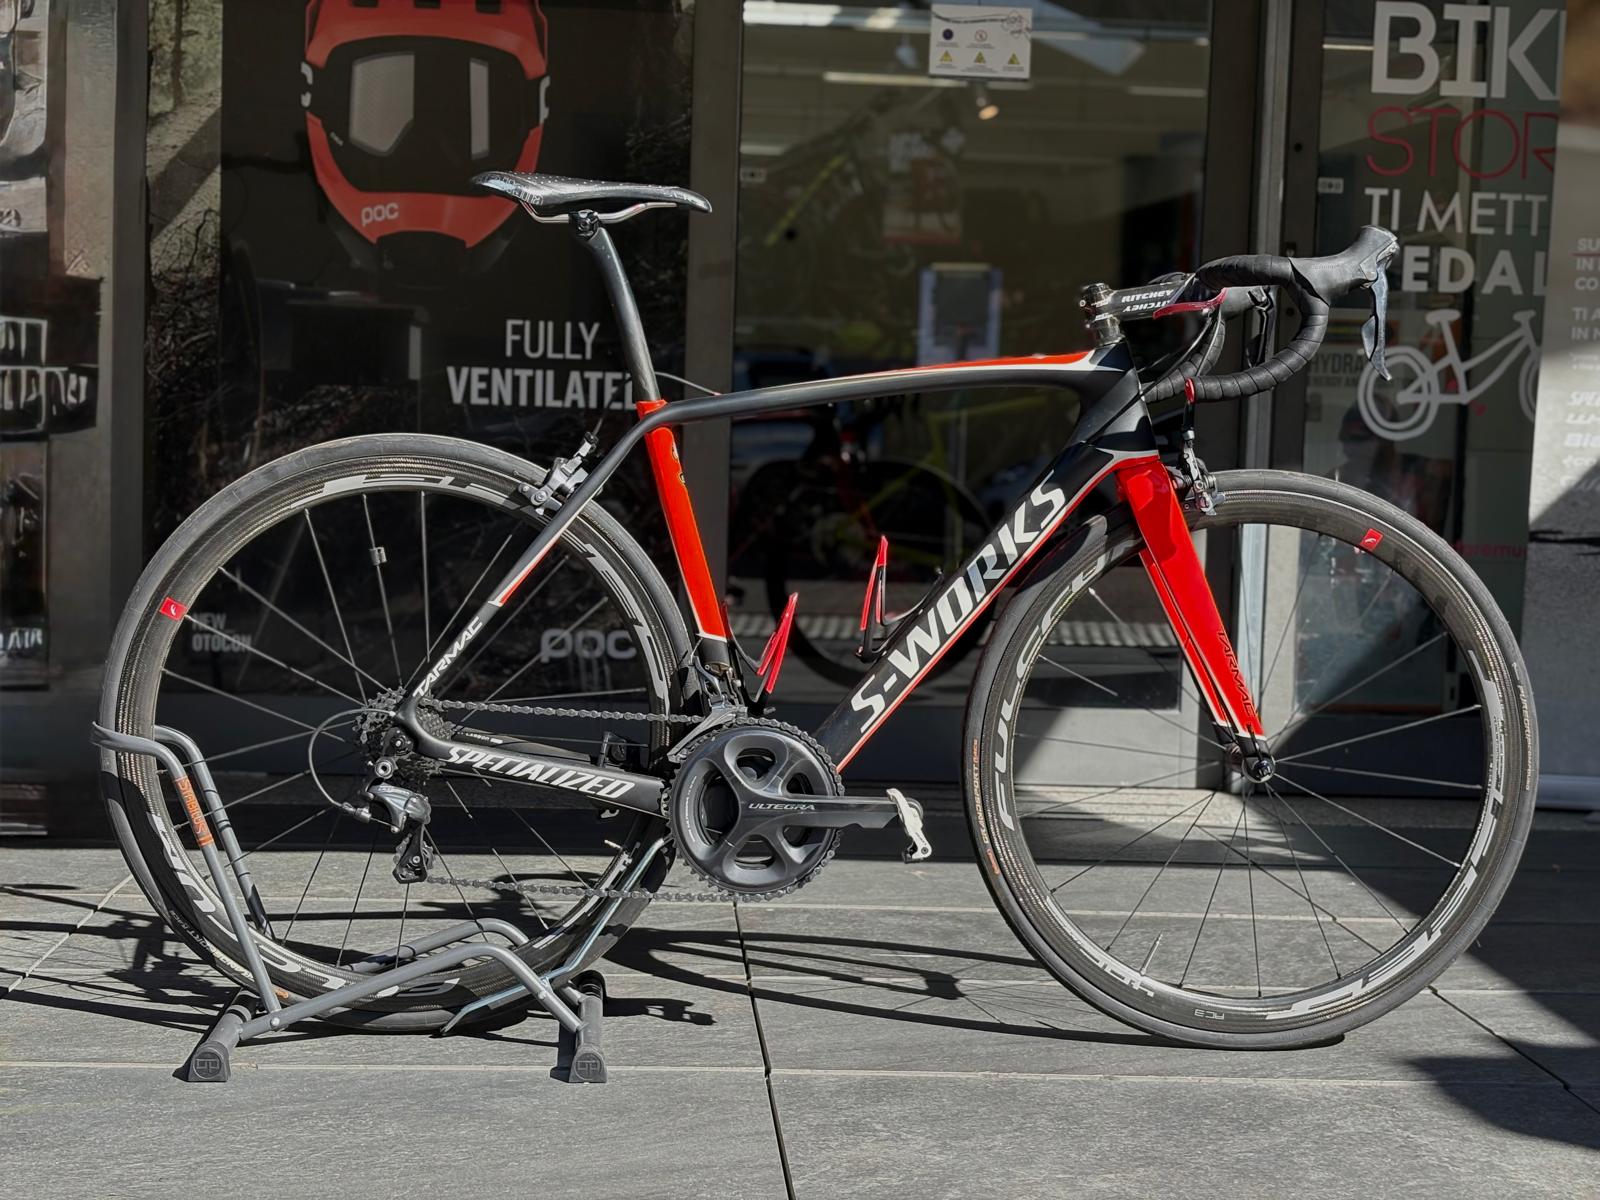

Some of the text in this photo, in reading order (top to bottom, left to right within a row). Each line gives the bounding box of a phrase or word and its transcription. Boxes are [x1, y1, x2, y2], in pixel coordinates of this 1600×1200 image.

[1371, 0, 1566, 100] BIK
[361, 202, 399, 228] poc
[1364, 187, 1548, 237] TI METT
[1402, 245, 1548, 295] EDAL
[1121, 289, 1174, 303] RITCHEY
[505, 319, 600, 360] FULLY
[851, 469, 1066, 734] S-WORKS
[413, 616, 483, 697] TARMAC
[540, 628, 637, 663] poc
[1217, 632, 1258, 716] TARMAC
[446, 747, 636, 799] SPECIALIZED
[749, 802, 816, 811] ULTEGRA
